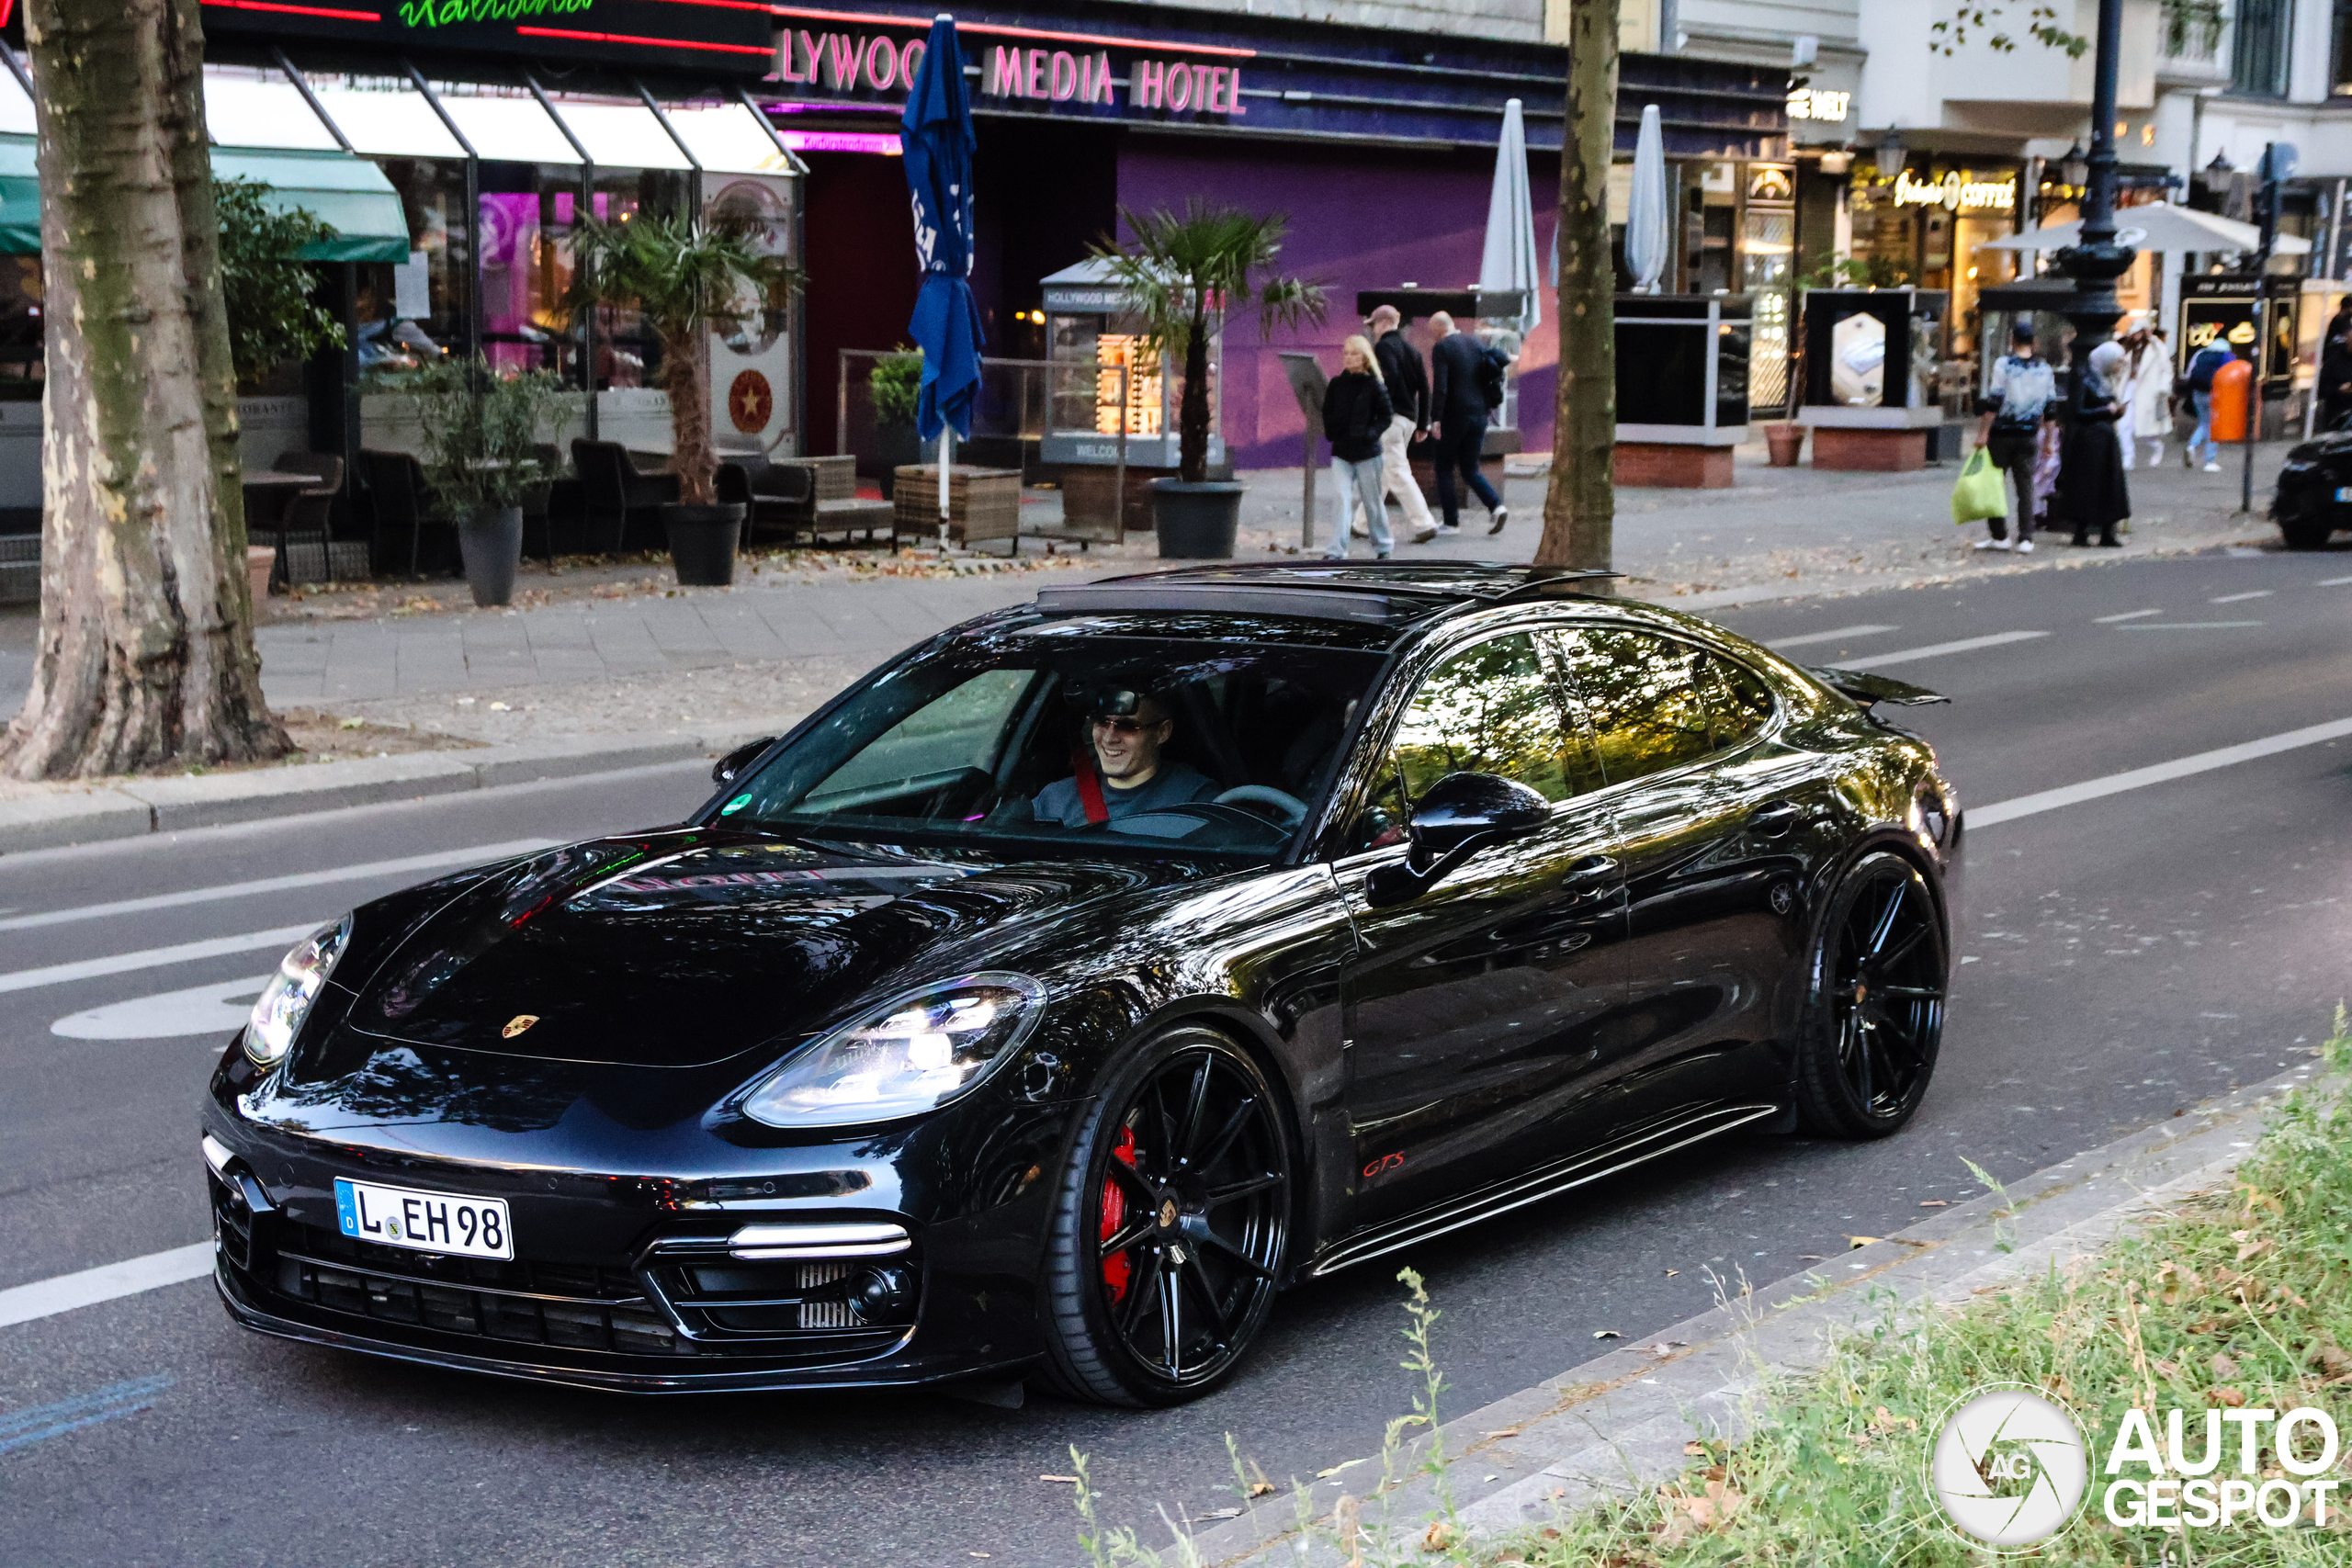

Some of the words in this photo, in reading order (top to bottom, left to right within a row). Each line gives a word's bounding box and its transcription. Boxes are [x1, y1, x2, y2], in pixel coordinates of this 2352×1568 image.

[992, 45, 1114, 106] MEDIA
[1140, 60, 1247, 114] HOTEL
[1960, 178, 2016, 208] COFFEE
[1047, 292, 1102, 304] HOLLYWOOD
[1363, 1151, 1405, 1177] GTS
